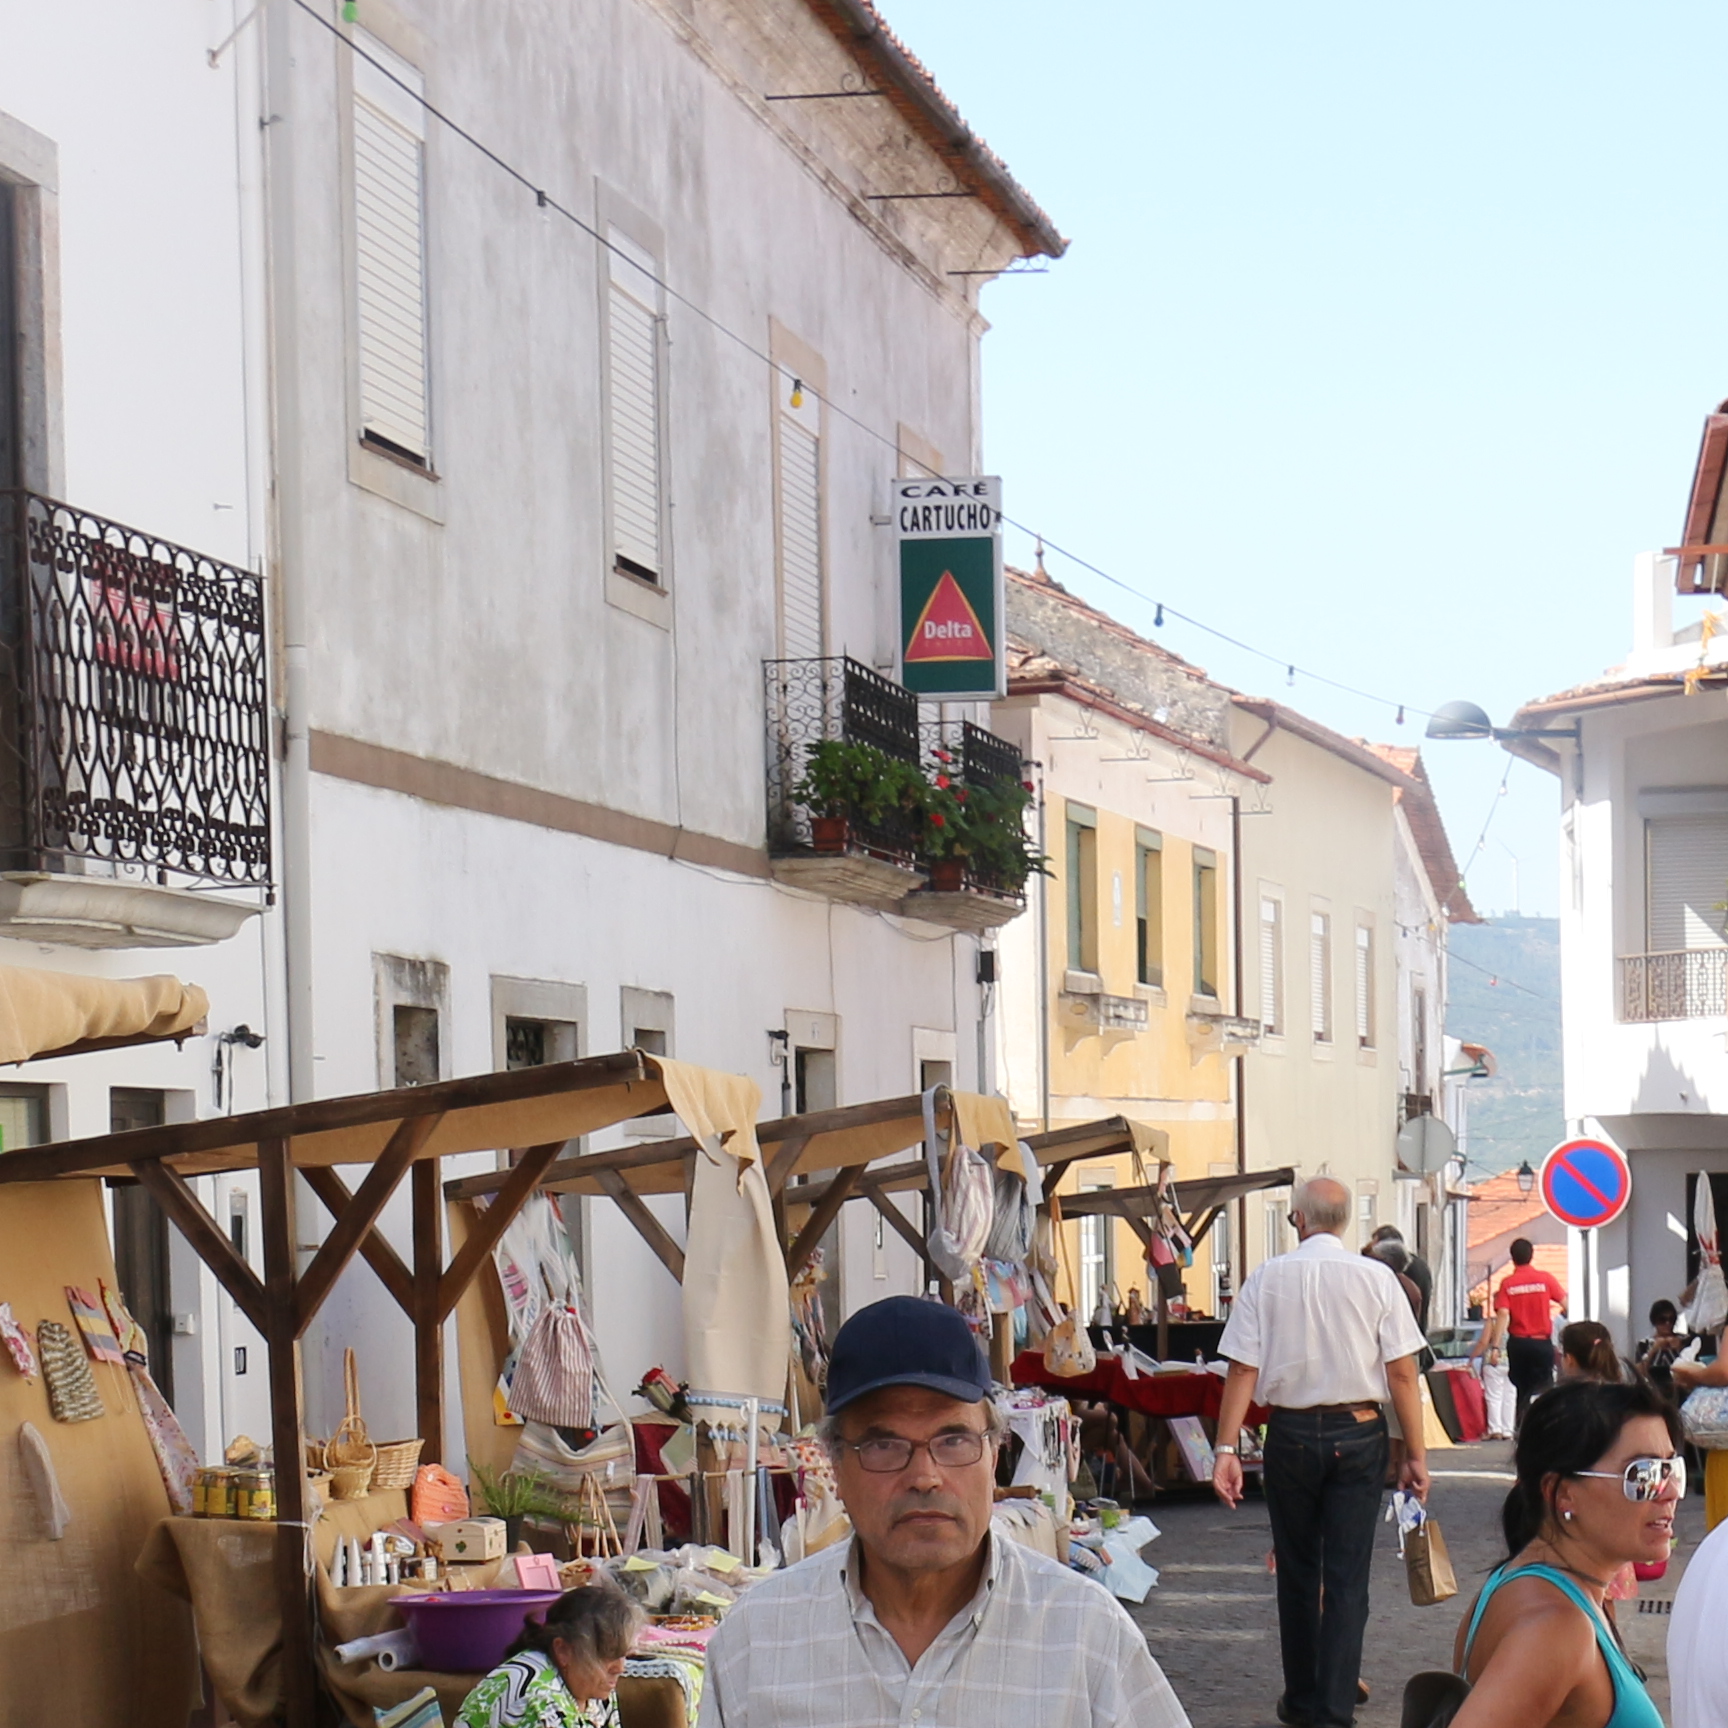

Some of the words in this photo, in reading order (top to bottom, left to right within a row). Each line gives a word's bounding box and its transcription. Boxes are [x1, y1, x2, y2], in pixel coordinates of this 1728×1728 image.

[901, 482, 989, 498] CAFÉ
[900, 503, 991, 532] CARTUCHO
[924, 620, 973, 639] Delta
